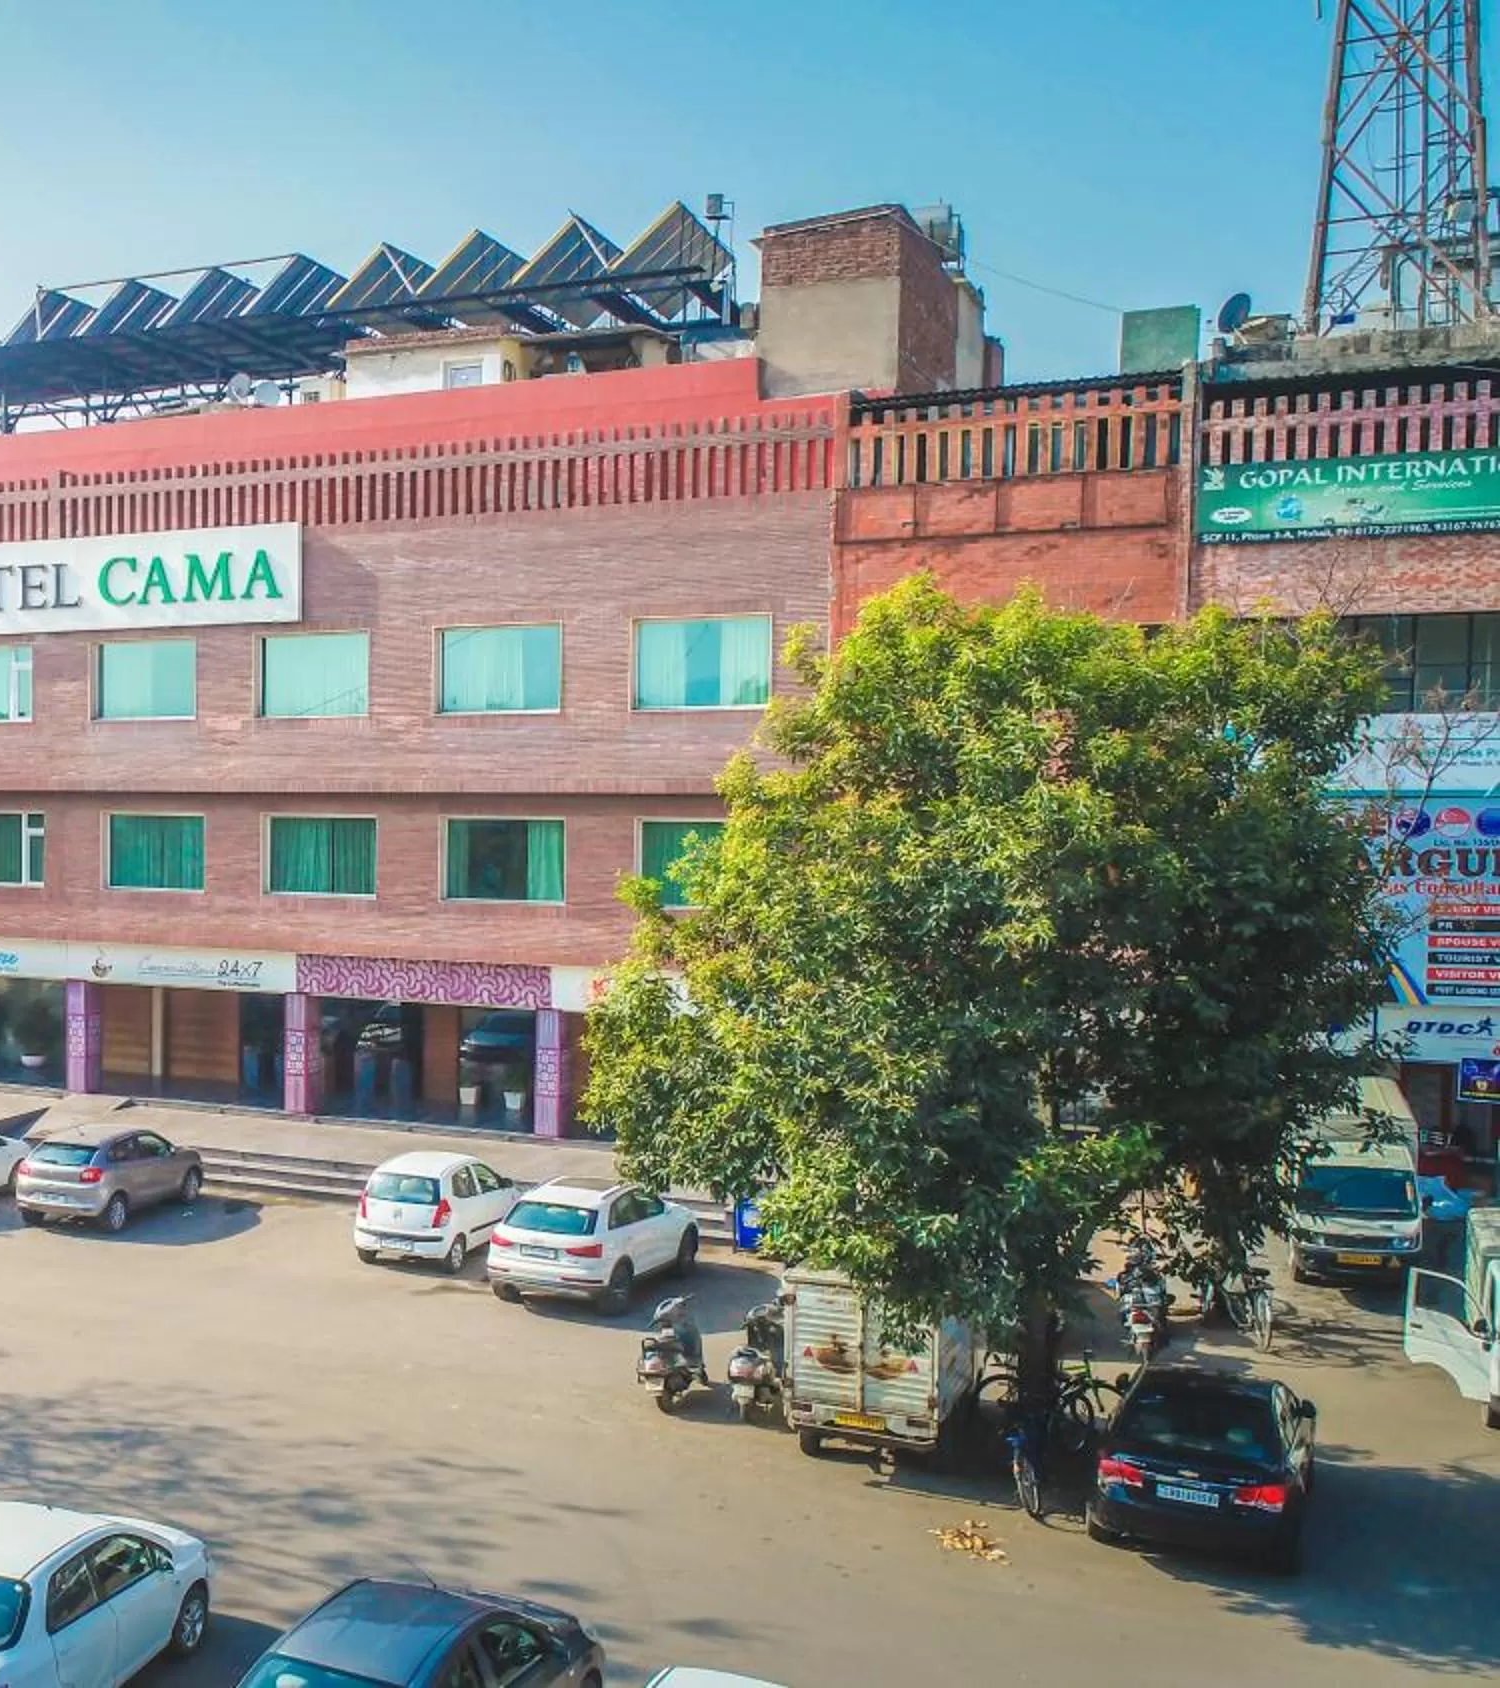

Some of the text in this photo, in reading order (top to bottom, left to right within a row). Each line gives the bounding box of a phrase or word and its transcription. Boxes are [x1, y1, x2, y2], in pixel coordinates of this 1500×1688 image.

[1240, 455, 1500, 489] GOPAL INTERNATI
[97, 549, 284, 606] CAMA
[1437, 938, 1487, 947] SPOUSE
[1436, 954, 1491, 963] TOURIST
[217, 959, 263, 977] 24x7
[1435, 970, 1486, 979] VISITOR
[1407, 1020, 1474, 1035] DTDC
